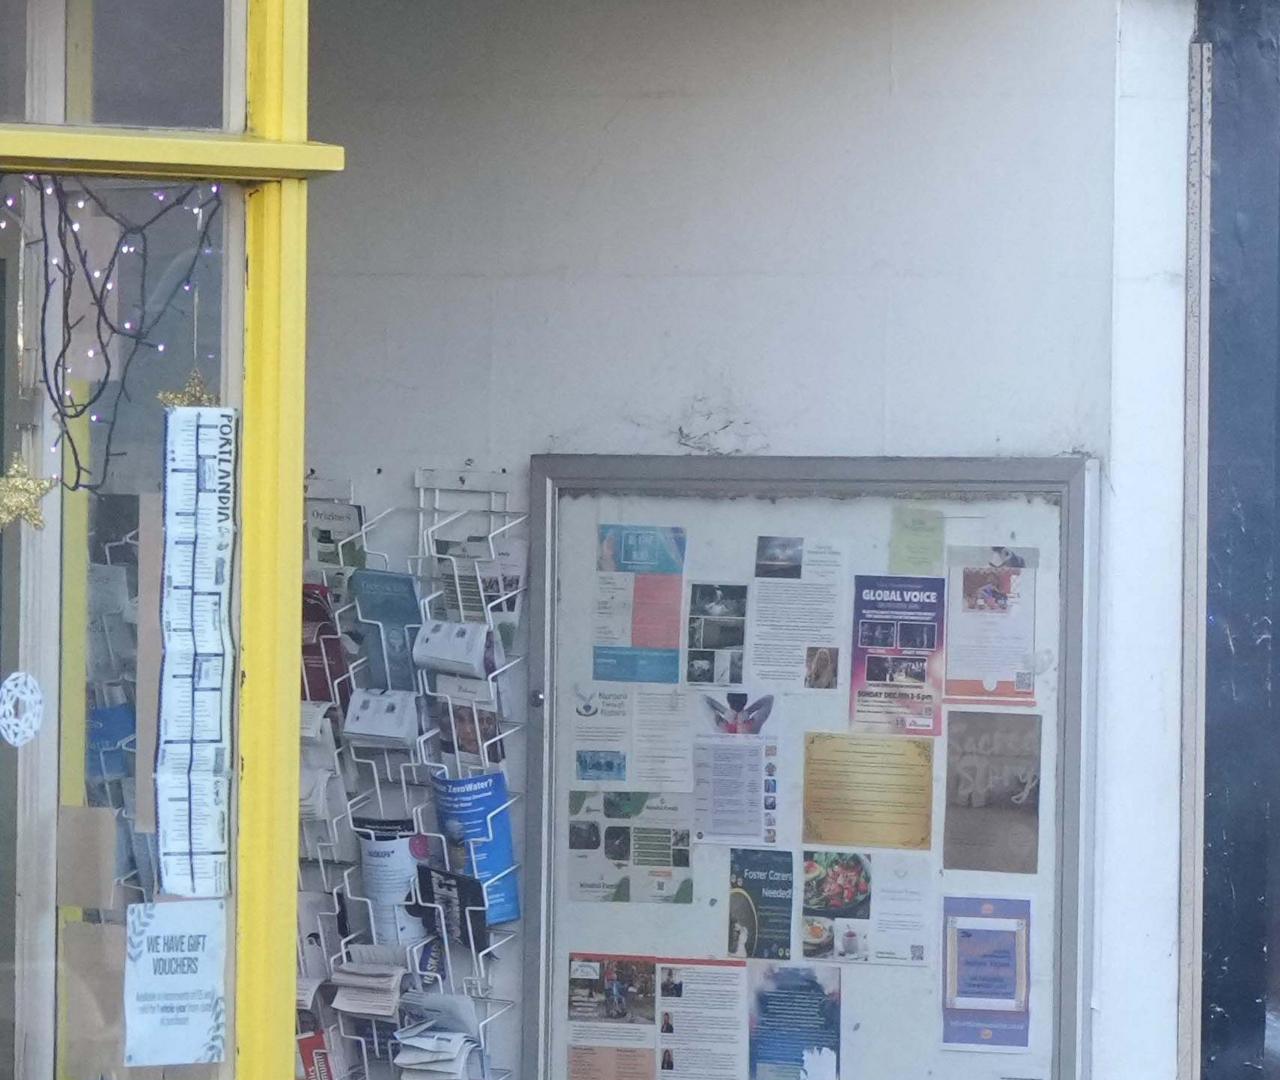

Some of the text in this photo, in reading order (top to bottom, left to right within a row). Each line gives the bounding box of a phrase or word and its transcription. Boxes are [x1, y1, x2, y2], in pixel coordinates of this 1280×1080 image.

[862, 589, 938, 604] GLOBAL VOICE
[447, 778, 493, 794] ZeroWater?
[744, 868, 768, 881] Foster
[146, 934, 207, 953] WE HAVE GIFT
[152, 957, 199, 975] VOUCHERS
